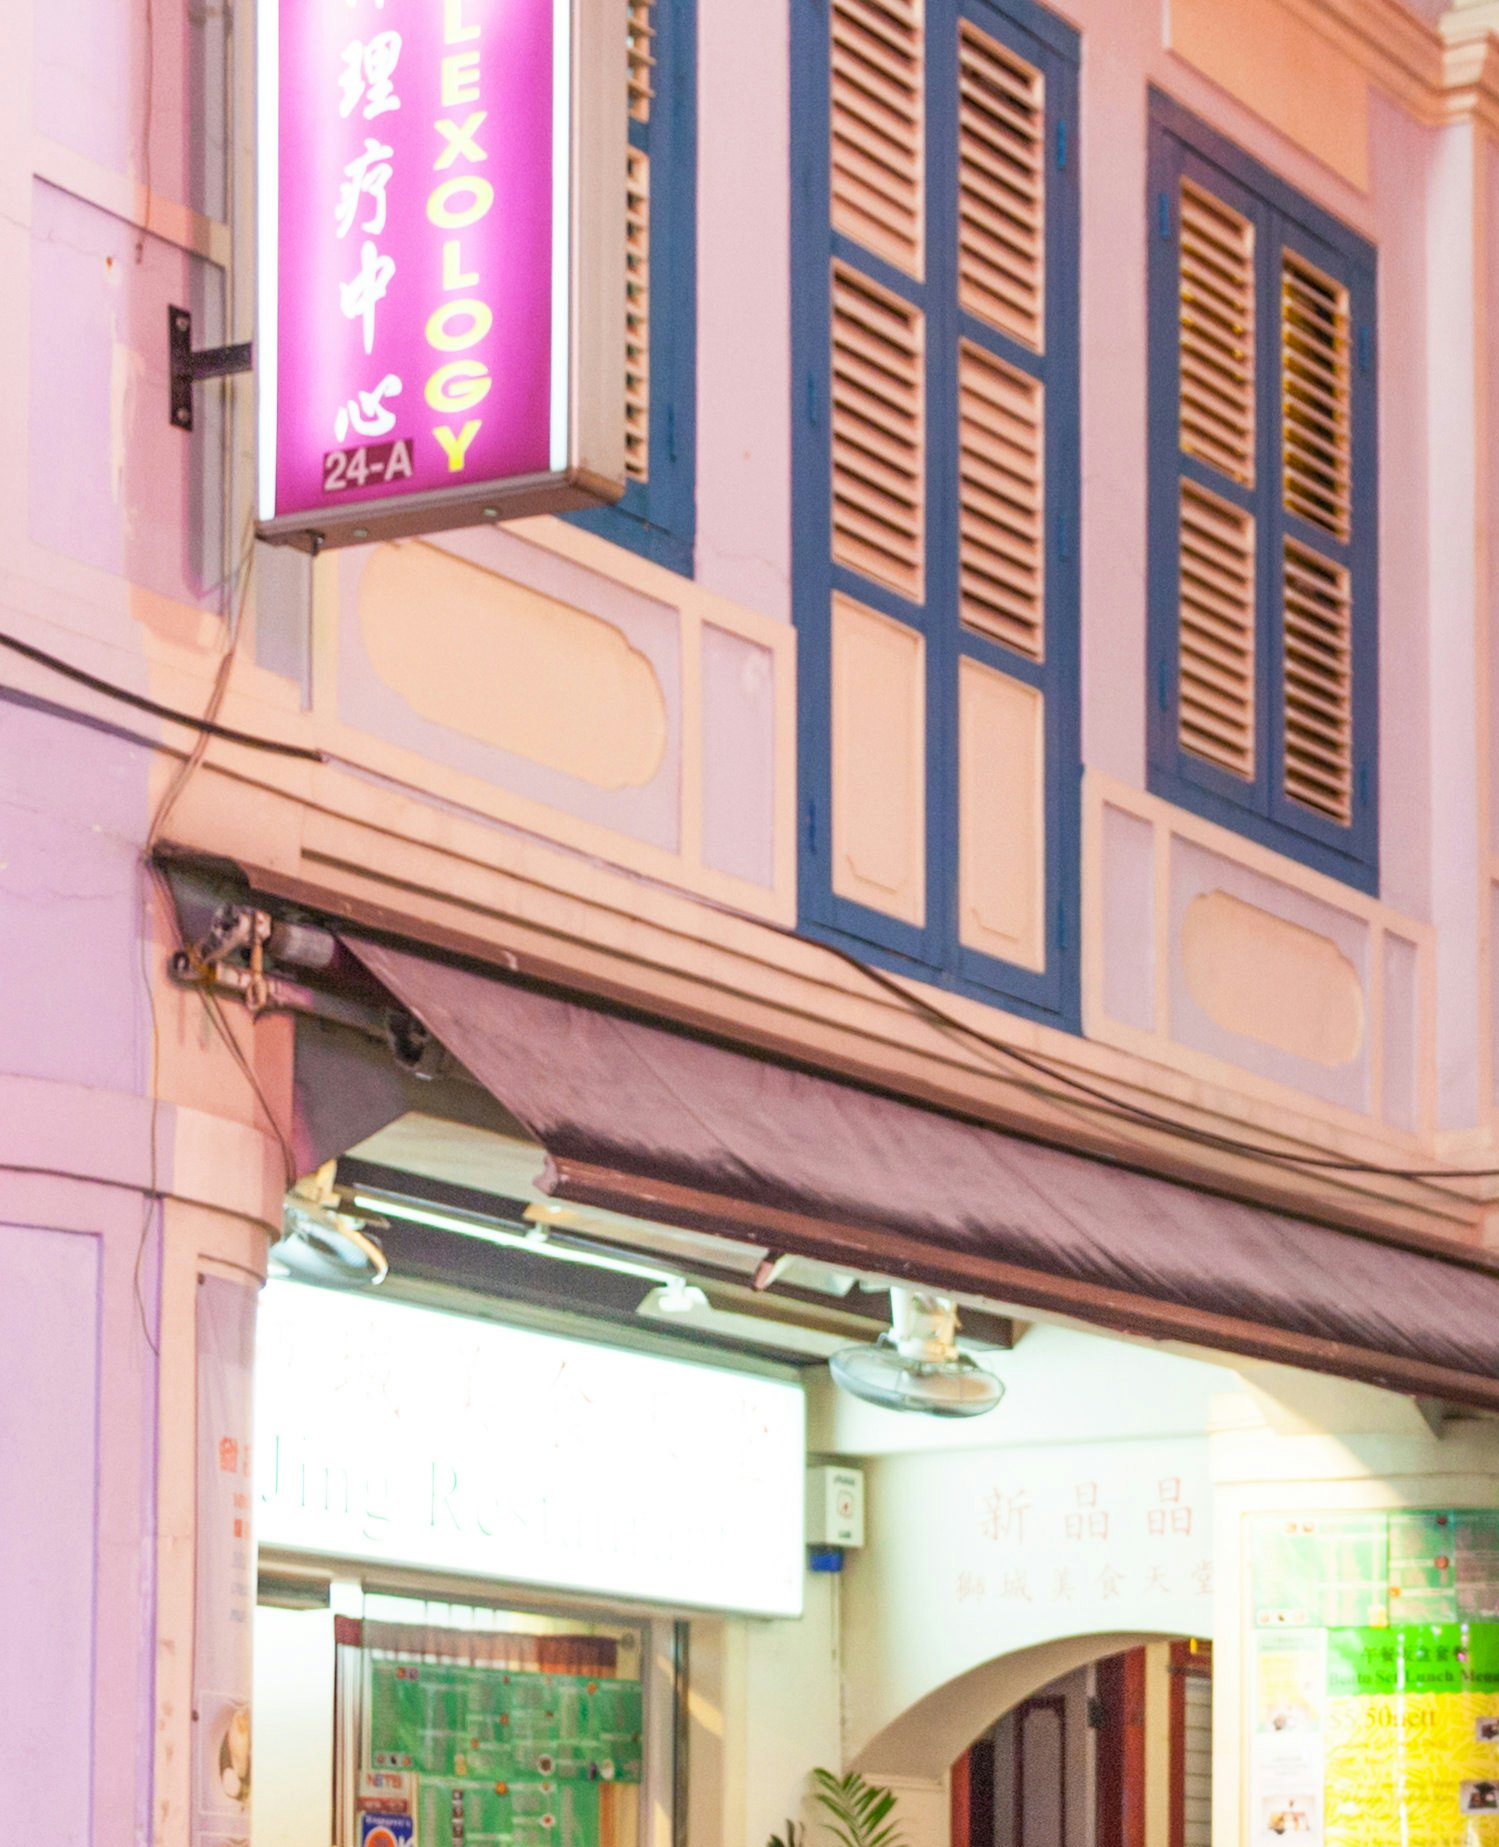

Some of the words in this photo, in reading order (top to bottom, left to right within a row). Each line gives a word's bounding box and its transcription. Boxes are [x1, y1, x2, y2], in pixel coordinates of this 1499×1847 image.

[335, 0, 402, 442] 理疗中心
[324, 440, 413, 491] 24-A
